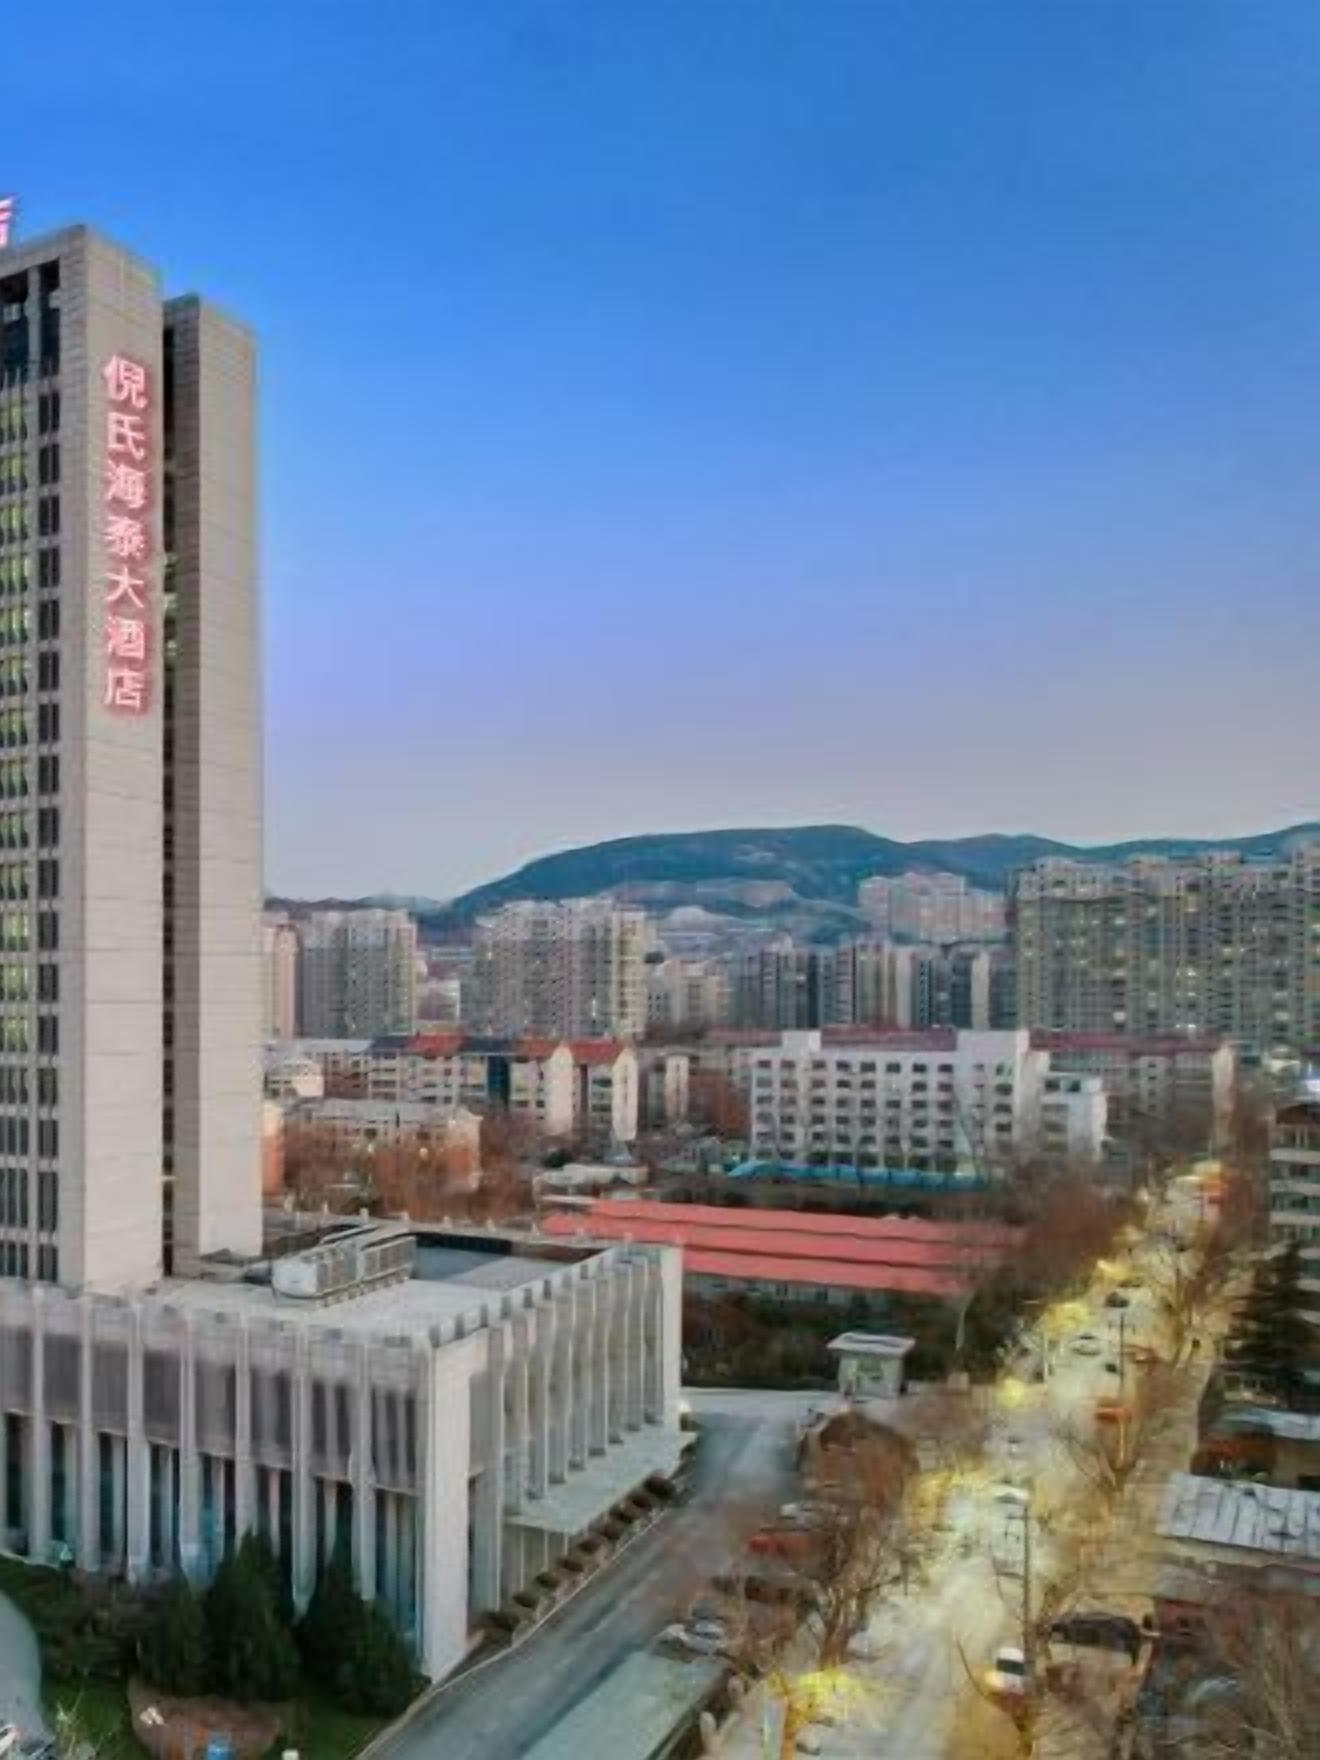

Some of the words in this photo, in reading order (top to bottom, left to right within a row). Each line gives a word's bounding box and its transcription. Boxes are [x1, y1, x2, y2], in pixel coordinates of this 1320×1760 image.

[104, 354, 147, 710] 倪氏海泰大酒店
